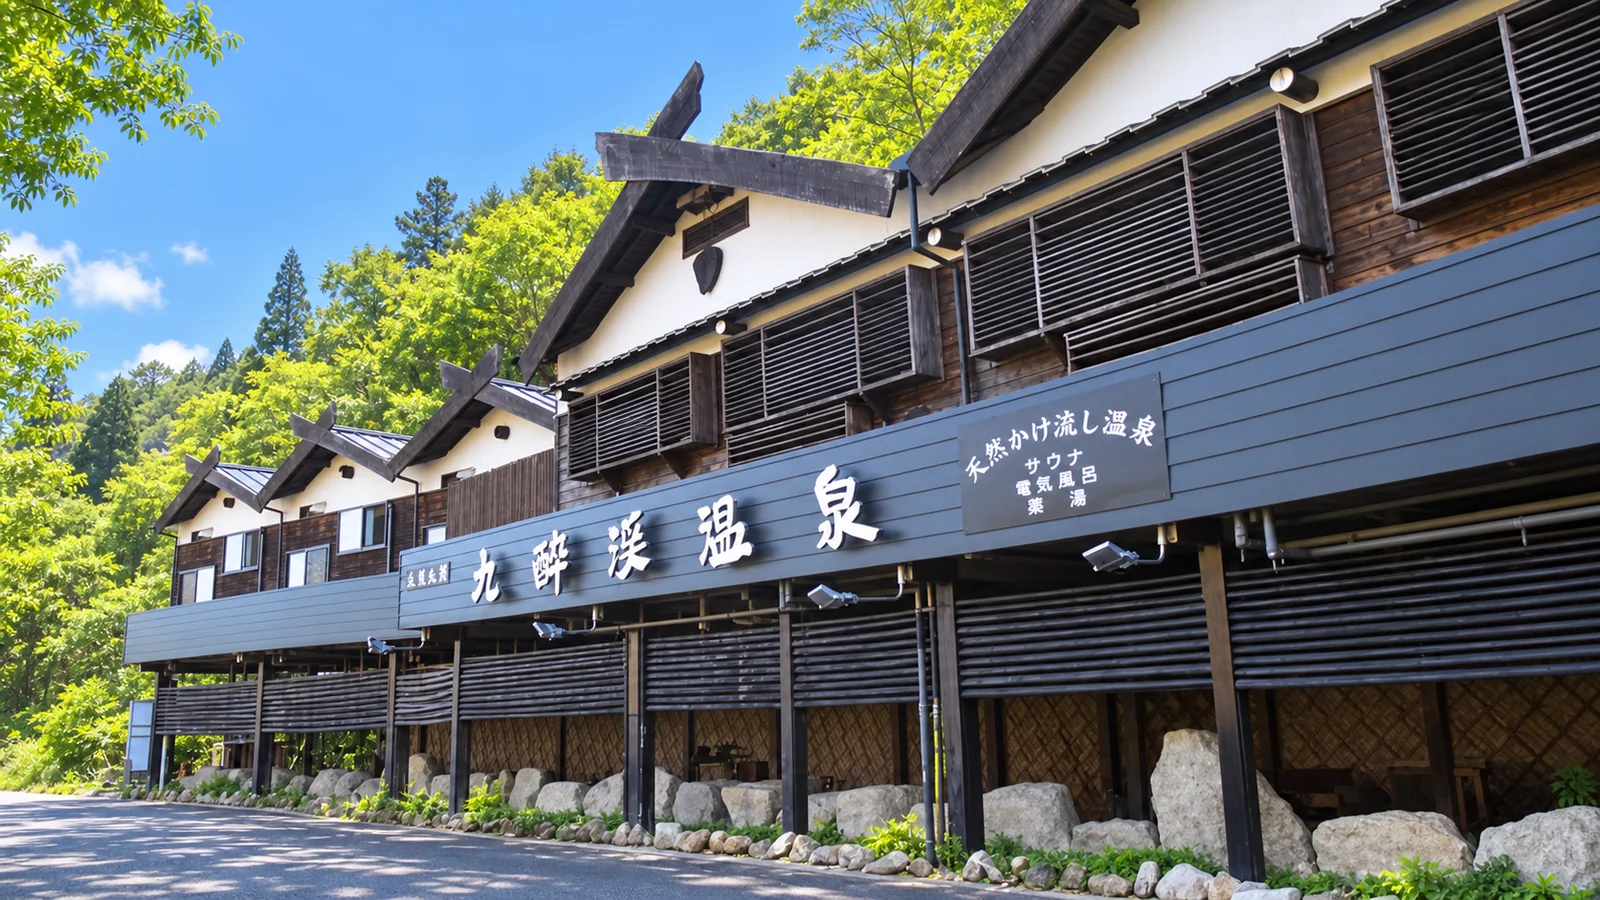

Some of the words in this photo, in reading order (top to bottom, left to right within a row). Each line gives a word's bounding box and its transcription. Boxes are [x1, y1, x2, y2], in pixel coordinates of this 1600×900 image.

[965, 410, 1156, 483] 天然かけ流し温泉
[1025, 449, 1083, 475] サウナ
[1016, 466, 1097, 496] 電気風呂
[1028, 489, 1087, 515] 薬湯
[471, 464, 880, 603] 九酔渓温泉
